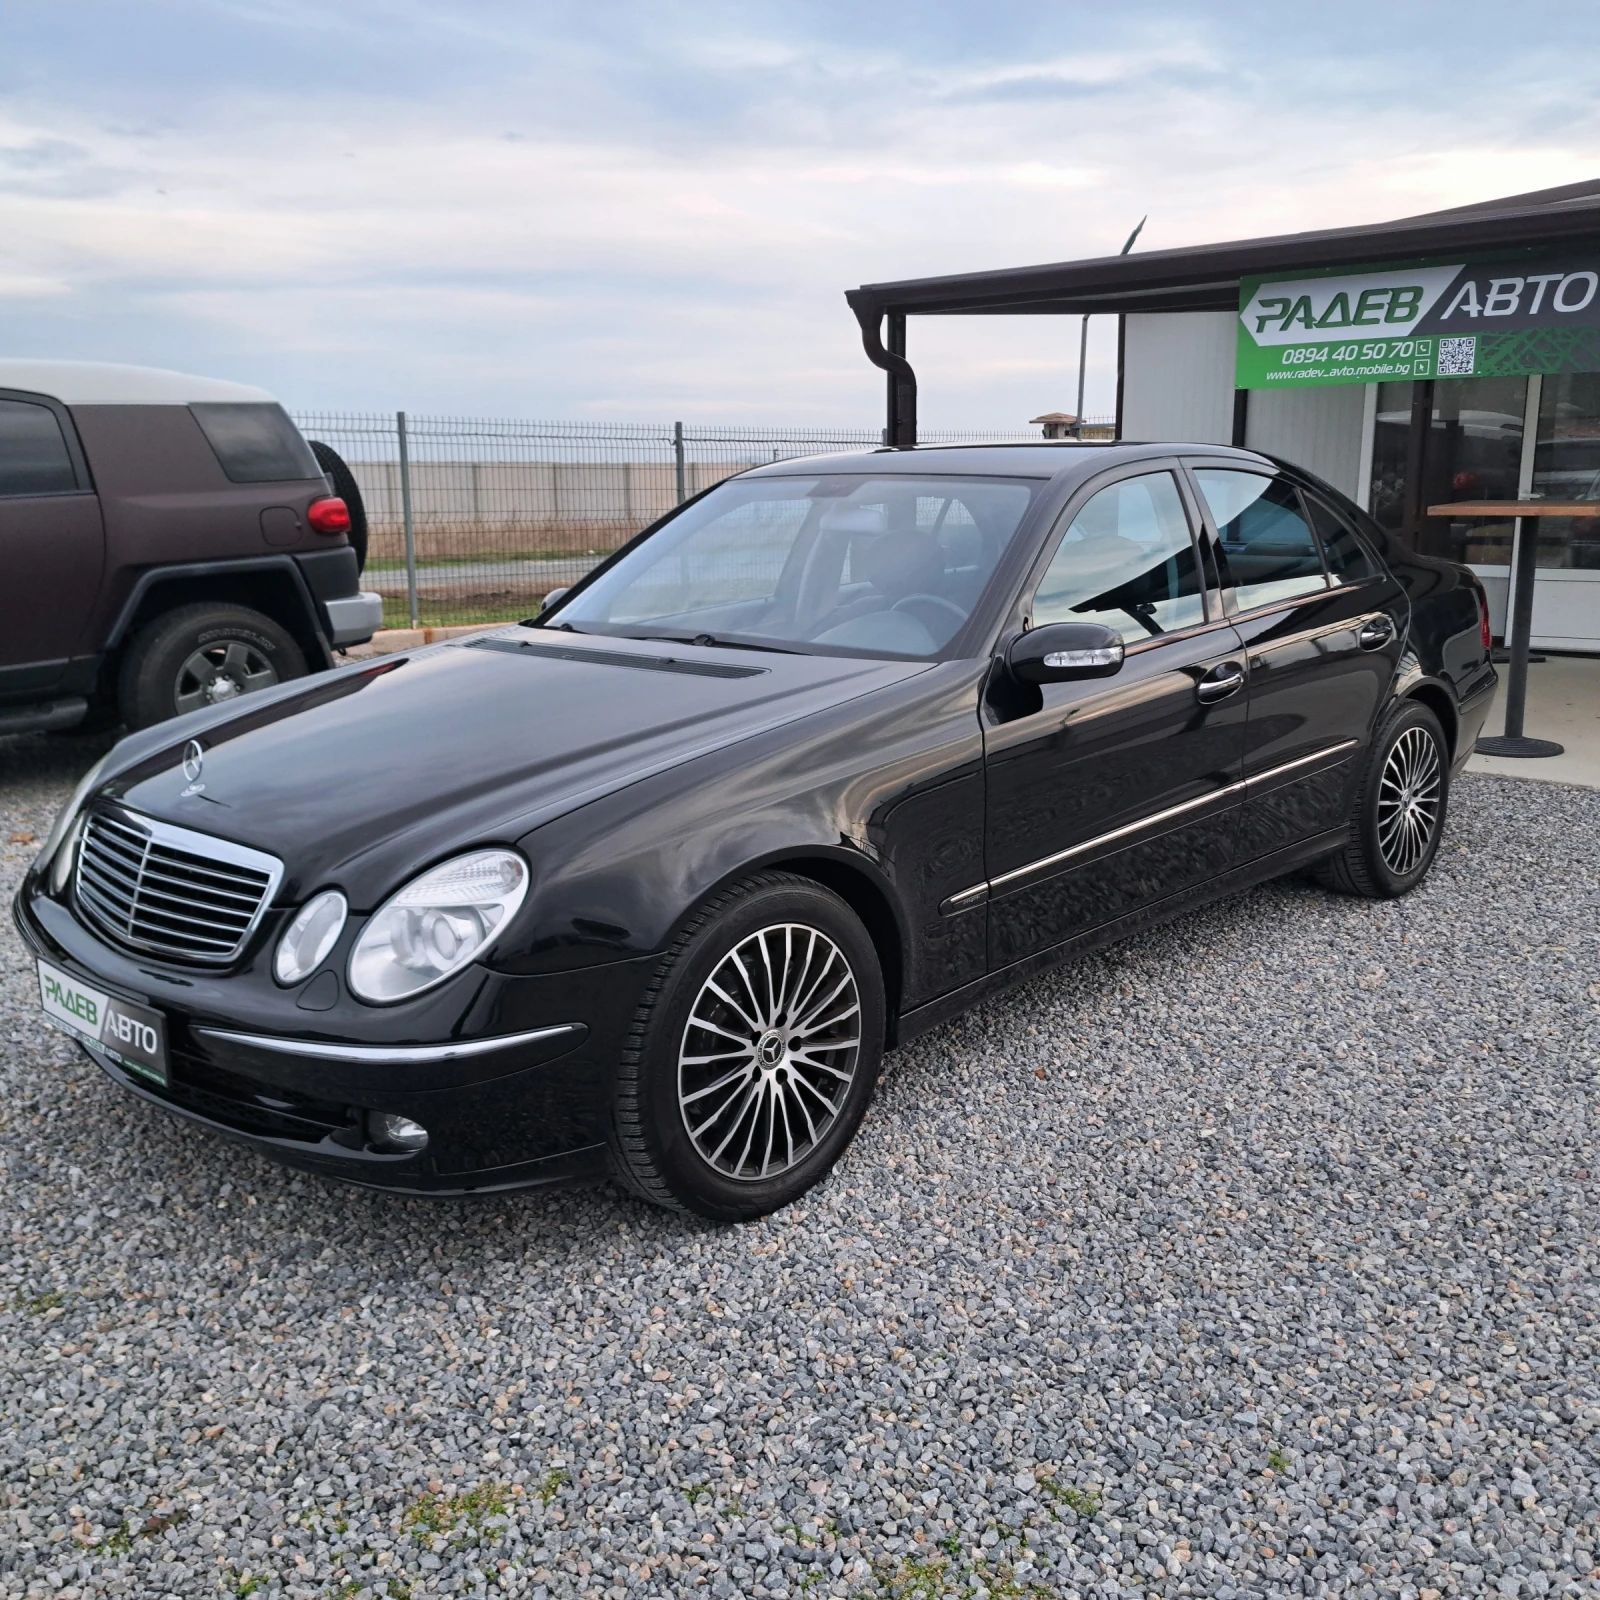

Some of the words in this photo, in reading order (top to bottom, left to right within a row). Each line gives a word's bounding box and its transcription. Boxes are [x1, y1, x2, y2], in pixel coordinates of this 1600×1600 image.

[1255, 285, 1425, 334] РАДЕВ
[1440, 271, 1598, 320] АВТО
[1266, 362, 1410, 380] www.radev_avto.mobile.bg
[1281, 346, 1329, 365] 0894
[1332, 344, 1358, 361] 40
[1360, 343, 1387, 360] 50
[1388, 341, 1414, 359] 70
[43, 973, 98, 1026] РАДЕВ
[104, 1009, 158, 1054] АВТО
